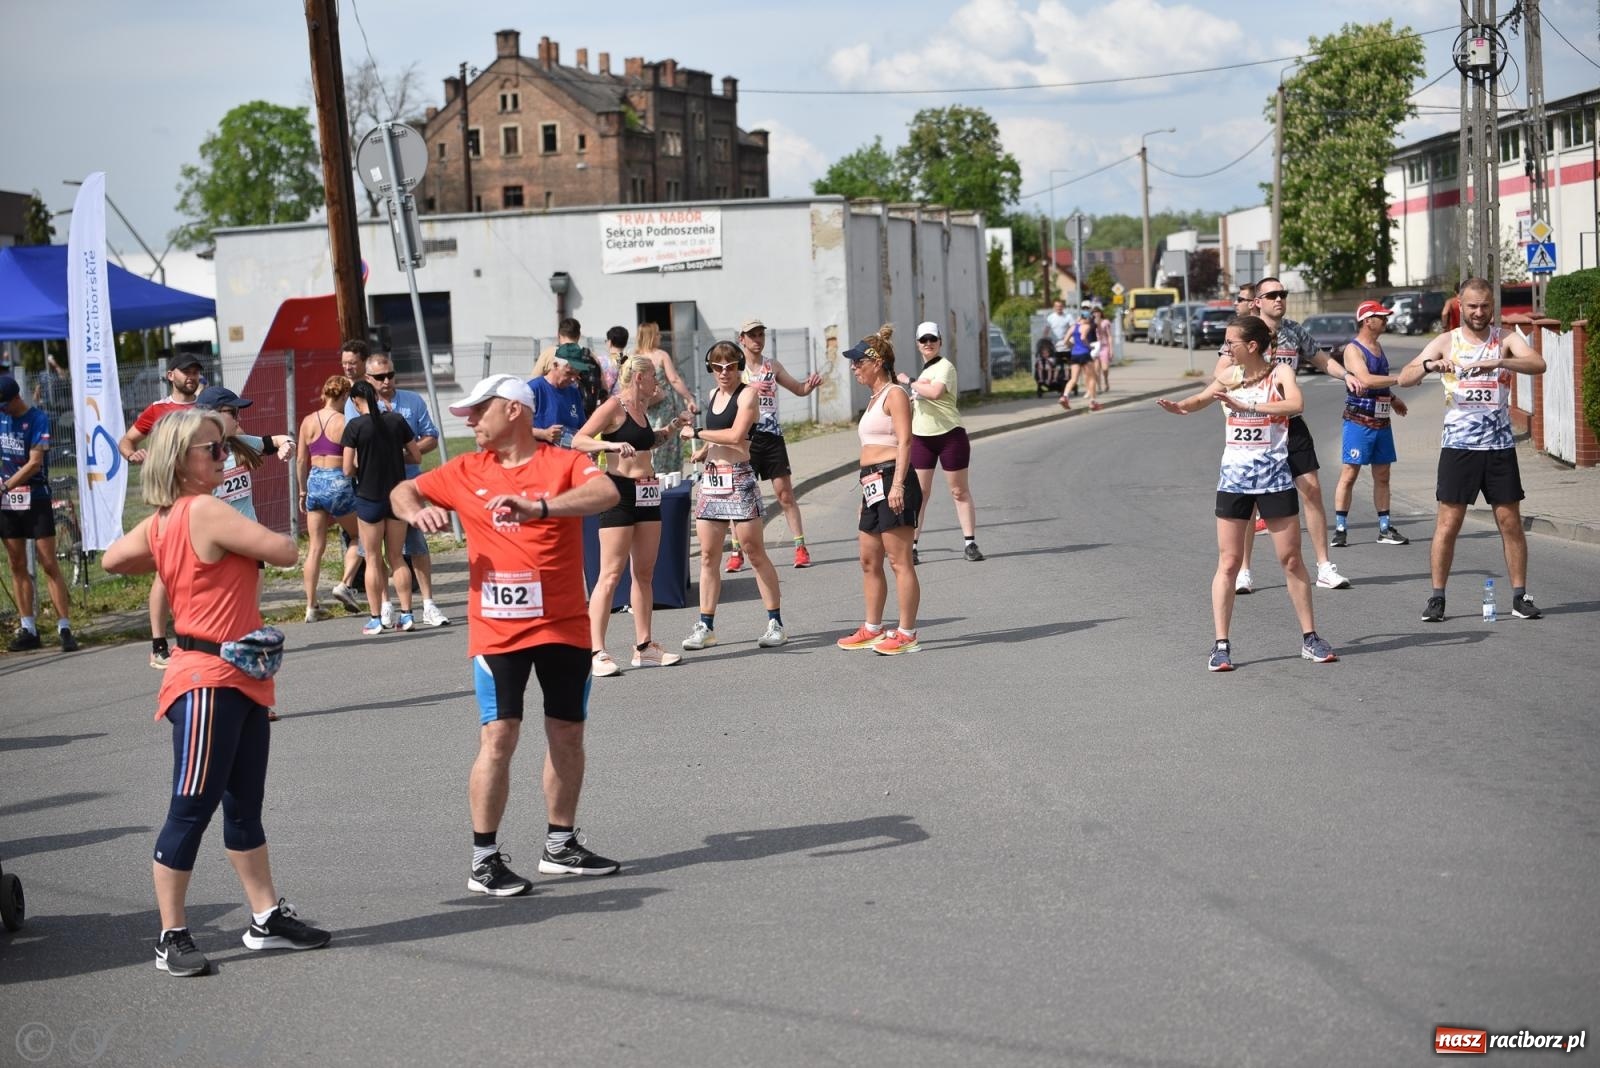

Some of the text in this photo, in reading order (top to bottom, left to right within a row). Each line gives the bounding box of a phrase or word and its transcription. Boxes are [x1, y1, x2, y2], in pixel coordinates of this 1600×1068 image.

[617, 208, 702, 225] TRWA NABÓR
[606, 225, 715, 238] Sekcja Podnoszenia
[90, 250, 101, 351] Raciborskie
[1465, 390, 1492, 401] 233
[1234, 428, 1263, 441] 232
[224, 475, 249, 493] 228
[492, 586, 529, 605] 162
